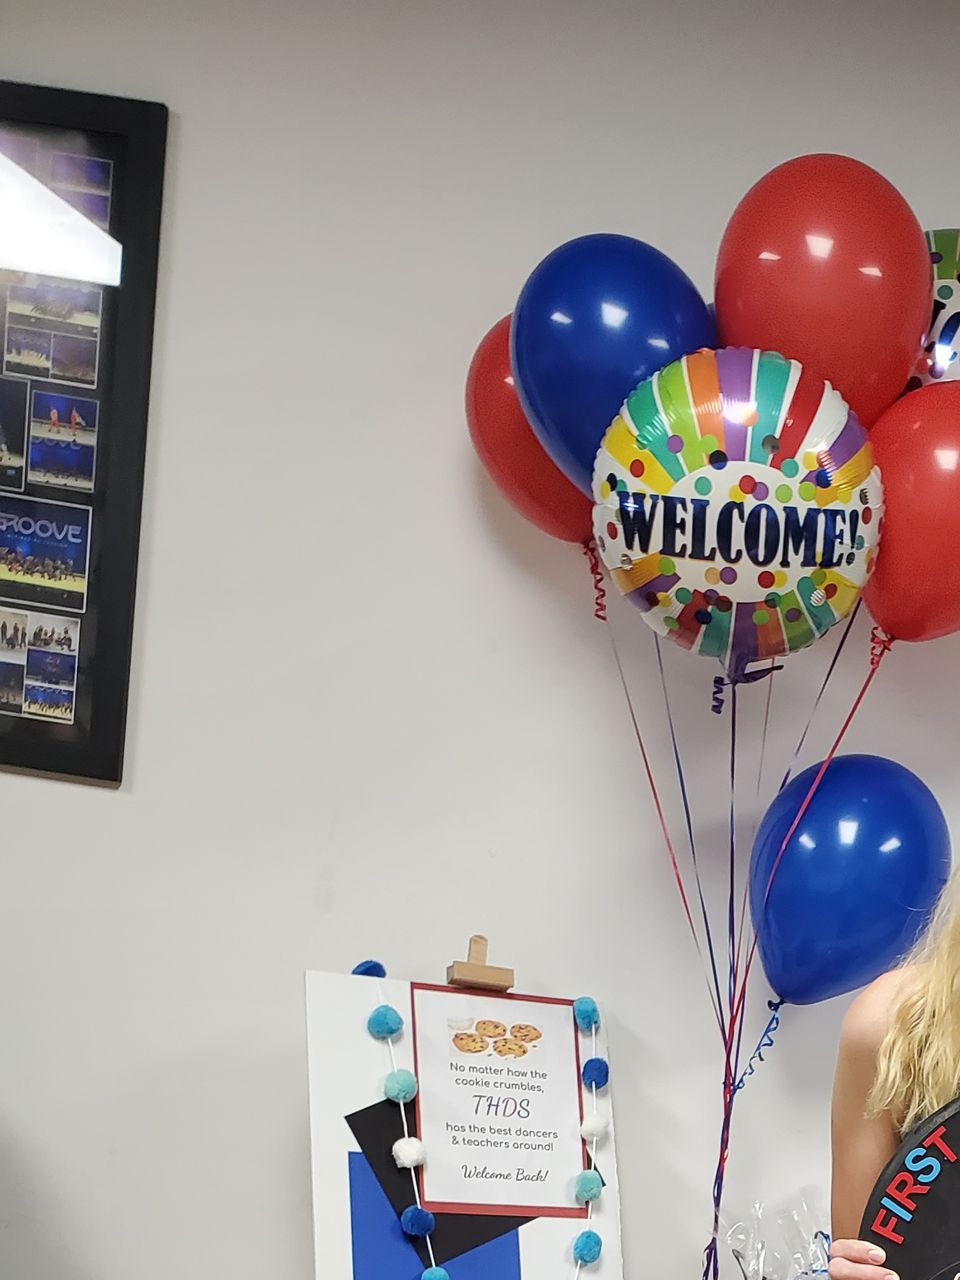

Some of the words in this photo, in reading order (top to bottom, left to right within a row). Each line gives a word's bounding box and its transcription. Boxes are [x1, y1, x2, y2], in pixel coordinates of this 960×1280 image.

[616, 491, 860, 568] WELCOME!
[450, 1062, 466, 1072] No
[468, 1065, 503, 1076] matter
[507, 1068, 528, 1078] how
[530, 1070, 548, 1080] the
[455, 1077, 490, 1088] cookie
[493, 1081, 545, 1094] crumbles,
[472, 1094, 531, 1119] THDS
[446, 1122, 466, 1133] has
[469, 1125, 487, 1135] the
[489, 1126, 513, 1136] best
[515, 1128, 559, 1139] dancers
[451, 1136, 460, 1145] &
[462, 1137, 510, 1149] teachers
[512, 1141, 554, 1151] around!
[461, 1165, 513, 1181] Welcome
[515, 1168, 550, 1183] Back!
[870, 1126, 959, 1245] FIRST
